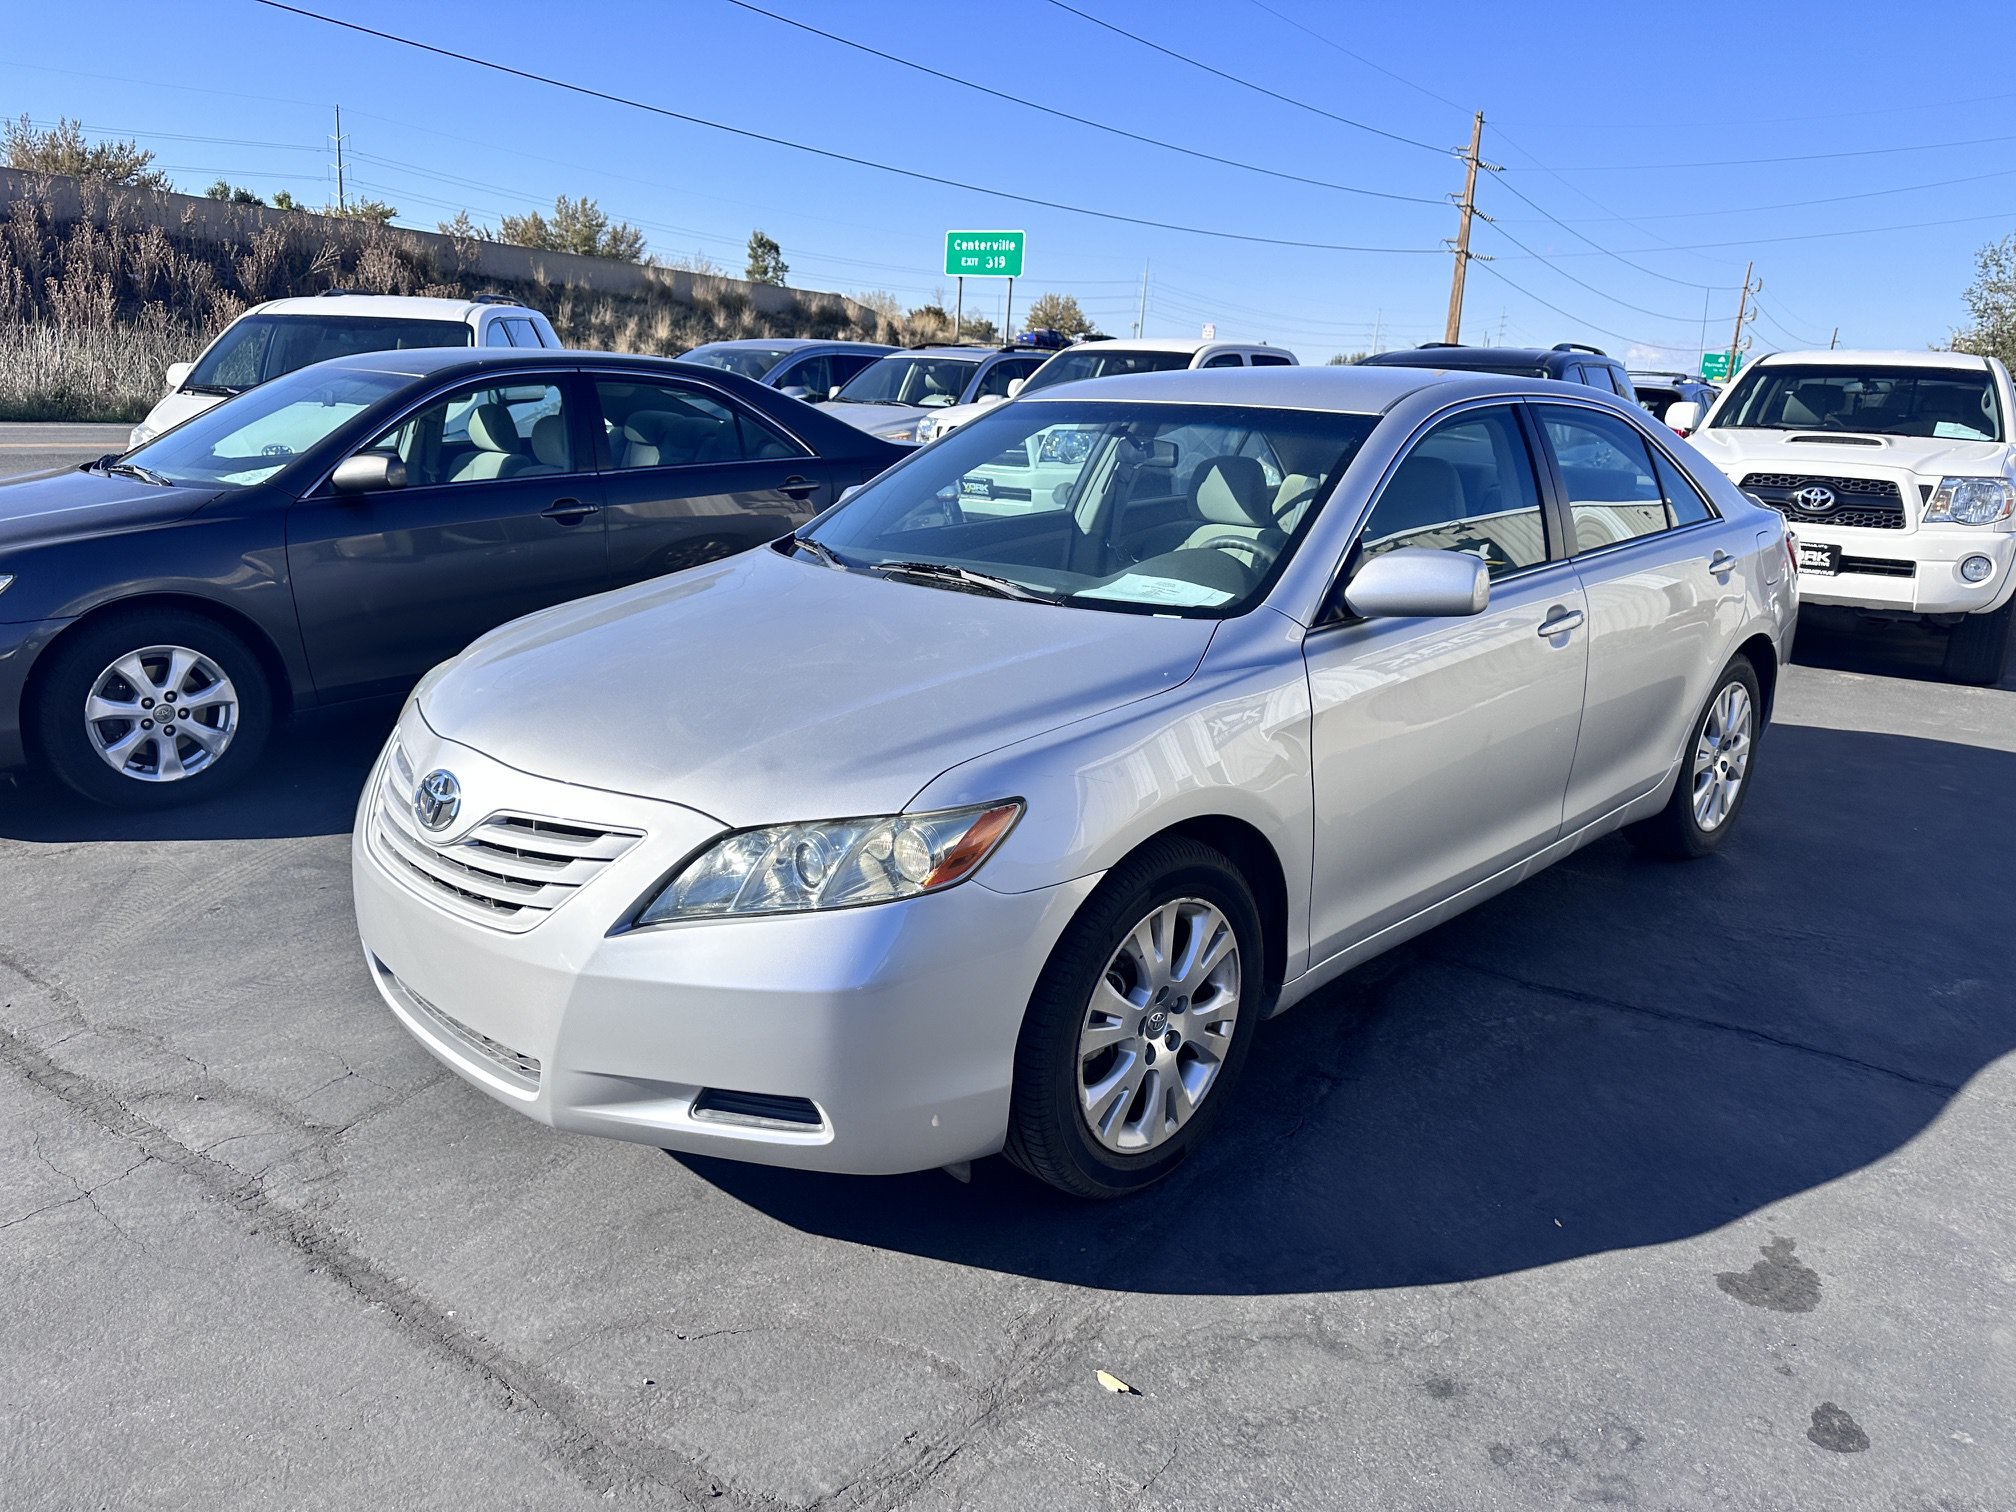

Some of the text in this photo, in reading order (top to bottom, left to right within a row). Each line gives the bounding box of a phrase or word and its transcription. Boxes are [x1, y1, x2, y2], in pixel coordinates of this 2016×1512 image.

[954, 239, 1016, 251] Centerville
[961, 255, 1006, 269] EXIT 319
[962, 481, 989, 492] YORK
